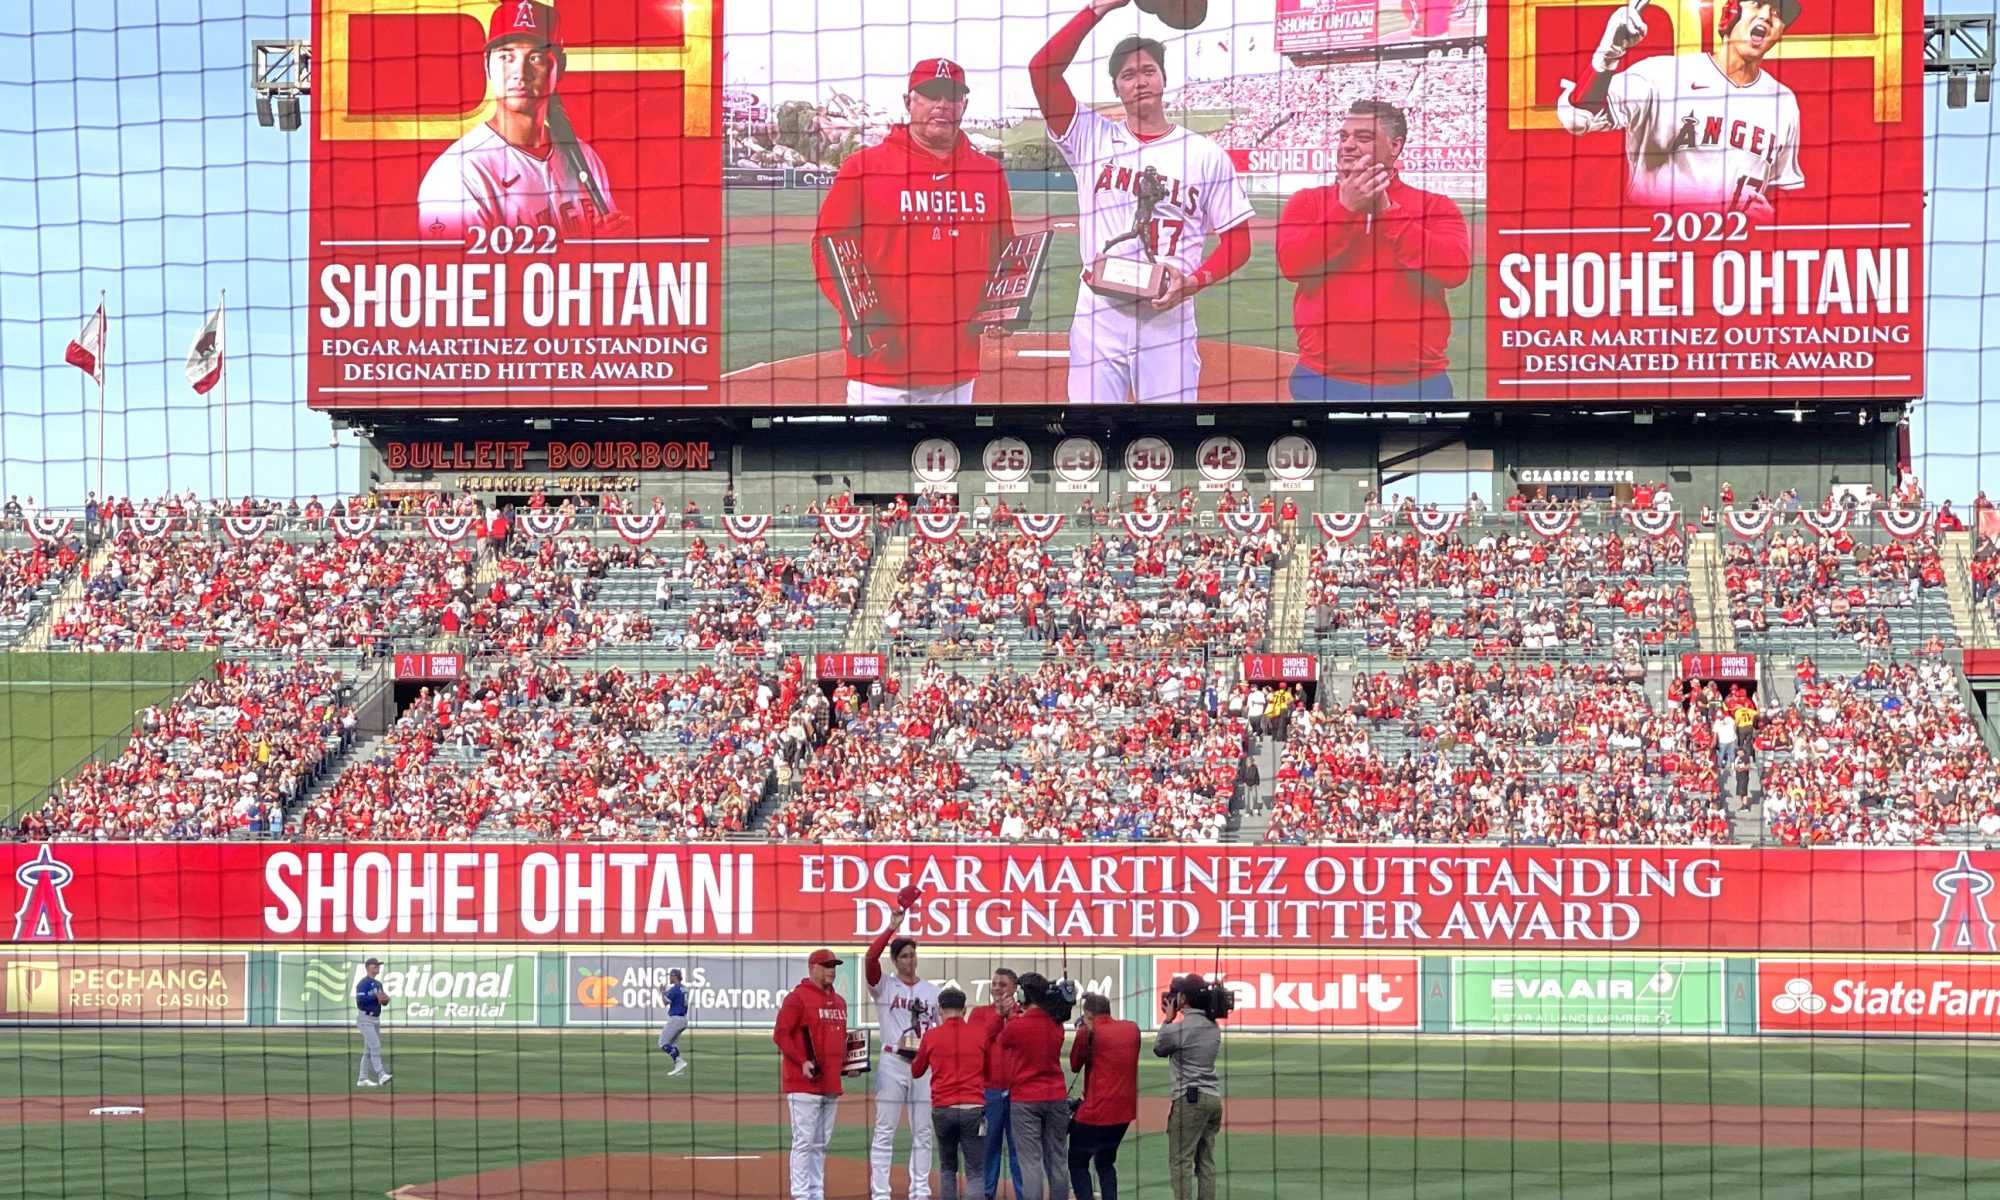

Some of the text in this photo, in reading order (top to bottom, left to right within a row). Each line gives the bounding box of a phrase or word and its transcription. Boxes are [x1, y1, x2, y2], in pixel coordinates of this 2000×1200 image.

[900, 190, 986, 214] ANGELS
[1150, 218, 1184, 256] 17
[1652, 212, 1749, 242] 2022
[466, 225, 558, 254] 2022
[1498, 247, 1909, 319] SHOHEI OHTANI
[320, 261, 709, 328] SHOHEI OHTANI
[321, 336, 708, 357] EDGAR MARTINEZ OUTSTANDING
[1501, 325, 1911, 348] EDGAR MARTINEZ OUTSTANDING
[343, 361, 674, 381] DESIGNATED HITTER AWARD
[1525, 351, 1874, 372] DESIGNATED HITTER AWARD
[387, 441, 710, 469] BULLEIT BOURBON
[991, 449, 1024, 472] 26
[1203, 445, 1237, 469] 42
[1521, 470, 1634, 482] CLASSIC HITS
[432, 656, 457, 666] SHOHEI
[432, 665, 457, 676] OHTANI
[853, 656, 879, 666] SHOHEI
[853, 666, 879, 676] OHTANI
[1282, 657, 1308, 667] SHOHEI
[1282, 667, 1308, 677] OHTANI
[1721, 657, 1748, 666] SHOHEI
[1721, 667, 1748, 677] OHTANI
[799, 854, 1724, 898] EDGAR MARTINEZ OUTSTANDING
[264, 851, 754, 934] SHOHEI OHTANI
[852, 898, 1640, 941] DESIGNATED HITTER AWARD
[69, 968, 228, 990] PECHANGA
[69, 993, 229, 1007] RESORT CASINO
[1172, 972, 1403, 1012] akult
[407, 1002, 505, 1018] Car Rental
